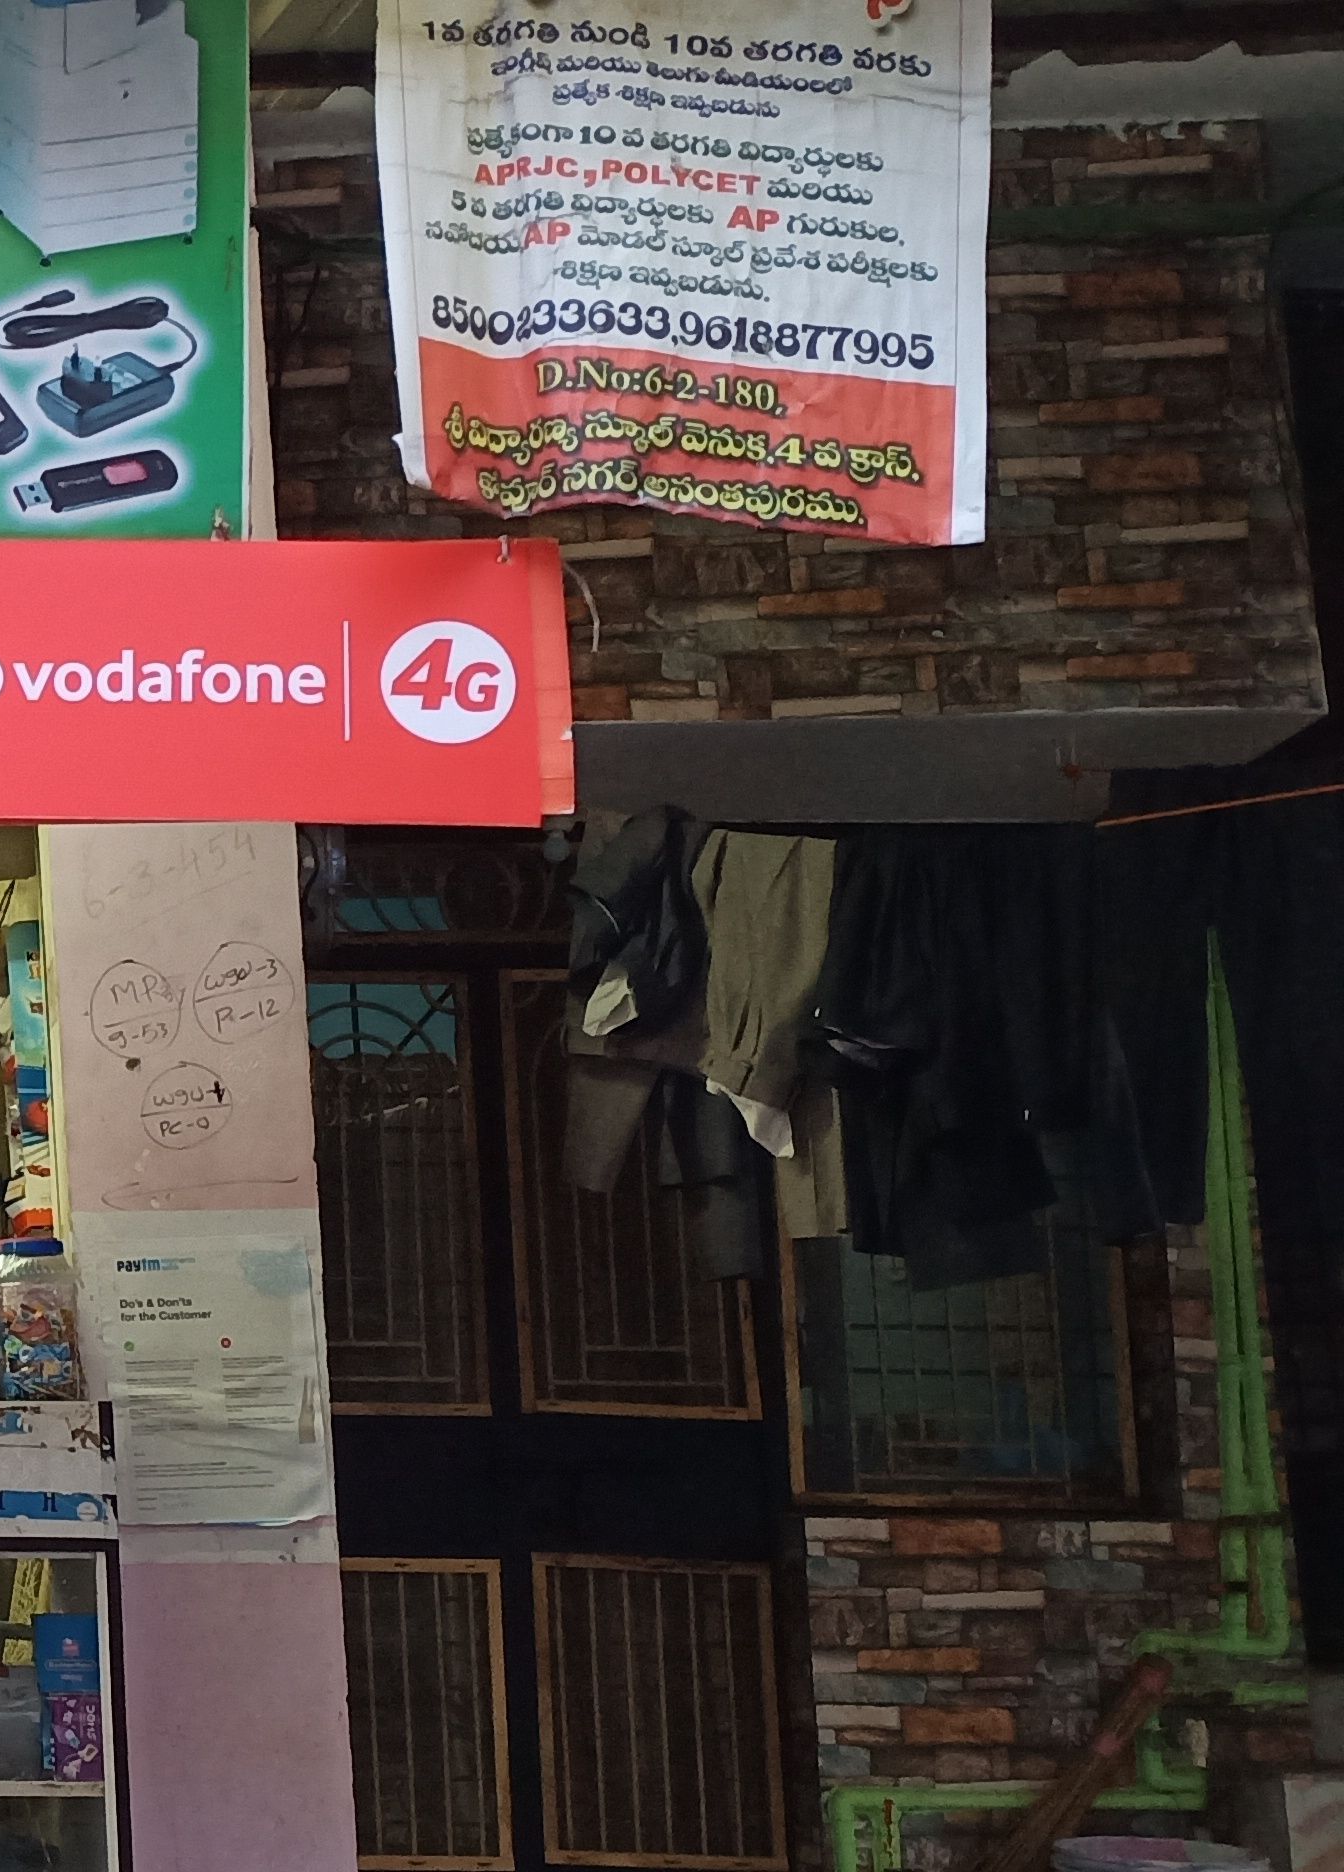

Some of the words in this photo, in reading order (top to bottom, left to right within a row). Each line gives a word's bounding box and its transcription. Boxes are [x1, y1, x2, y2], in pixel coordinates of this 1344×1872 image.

[474, 19, 559, 46] తరగతి
[571, 20, 650, 49] నుండి
[743, 40, 842, 65] తరగతి
[853, 48, 931, 77] వరకు
[580, 126, 616, 144] 10
[651, 130, 731, 157] తరగతి
[767, 178, 873, 205] మరియు
[727, 205, 779, 231] AP
[524, 221, 570, 249] AP
[585, 411, 677, 451] స్కూల్
[17, 648, 328, 705] vodafone
[387, 638, 505, 710] 4G
[121, 1312, 137, 1322] for
[140, 1312, 157, 1321] the
[160, 1310, 212, 1321] Customer
